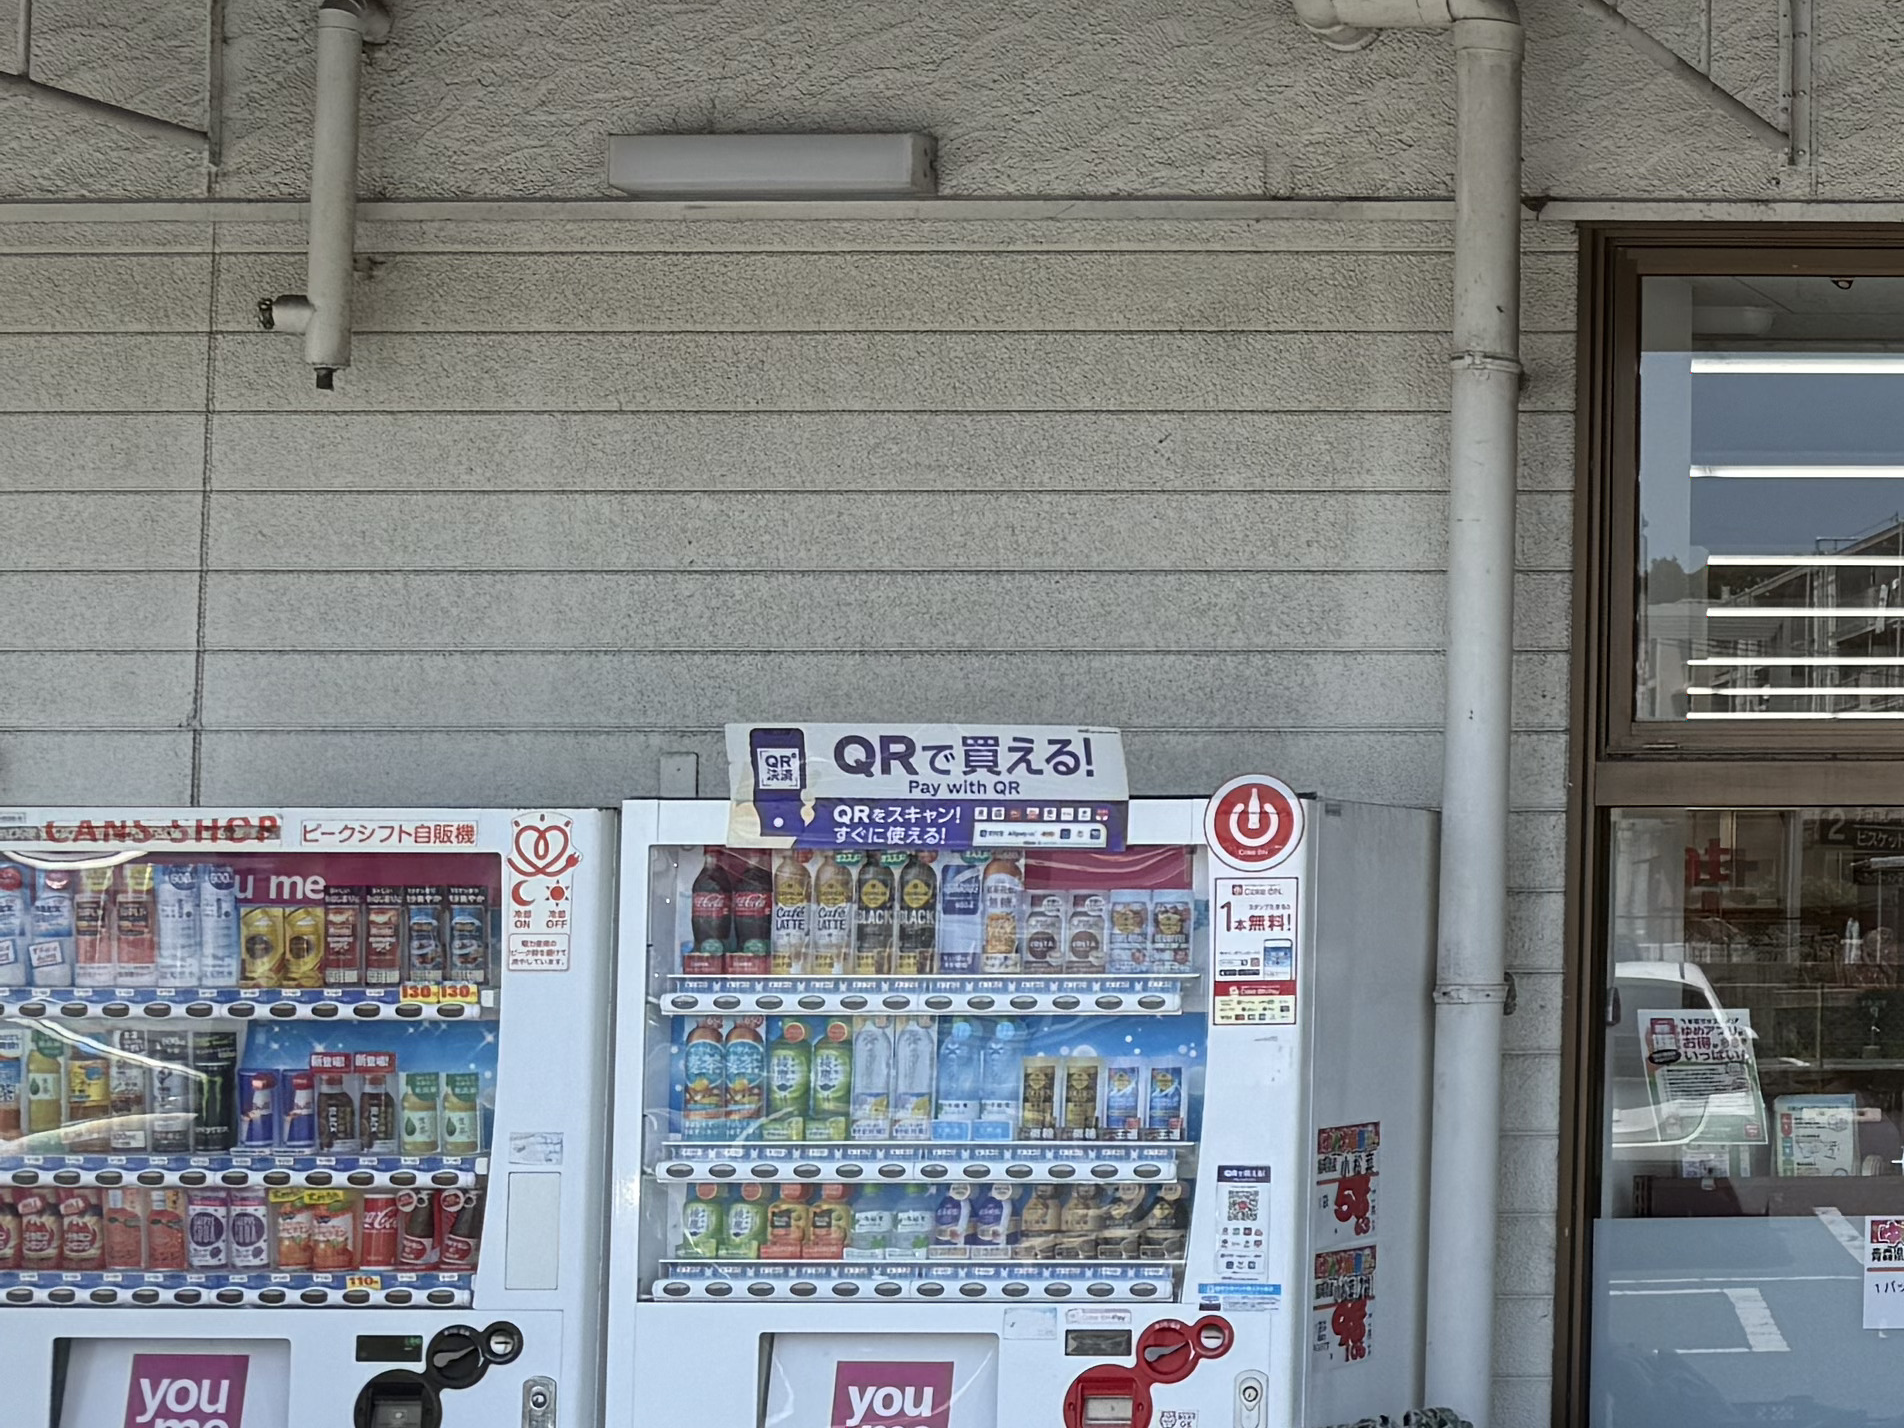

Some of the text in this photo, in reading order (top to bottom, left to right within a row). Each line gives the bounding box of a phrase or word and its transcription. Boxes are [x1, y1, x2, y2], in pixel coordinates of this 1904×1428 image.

[833, 735, 1095, 778] QRで買える!
[908, 780, 1021, 796] Pay with QR
[832, 805, 961, 824] QRをスキャン!
[302, 824, 476, 845] ピークシフト自販機
[833, 826, 947, 845] すぐに使える!
[269, 874, 326, 900] me
[514, 919, 568, 929] ON OFF
[776, 919, 804, 931] LATTE
[818, 919, 846, 931] LATTE
[401, 985, 432, 999] 130
[441, 985, 471, 999] 130
[135, 1377, 230, 1423] you
[845, 1384, 934, 1428] you
